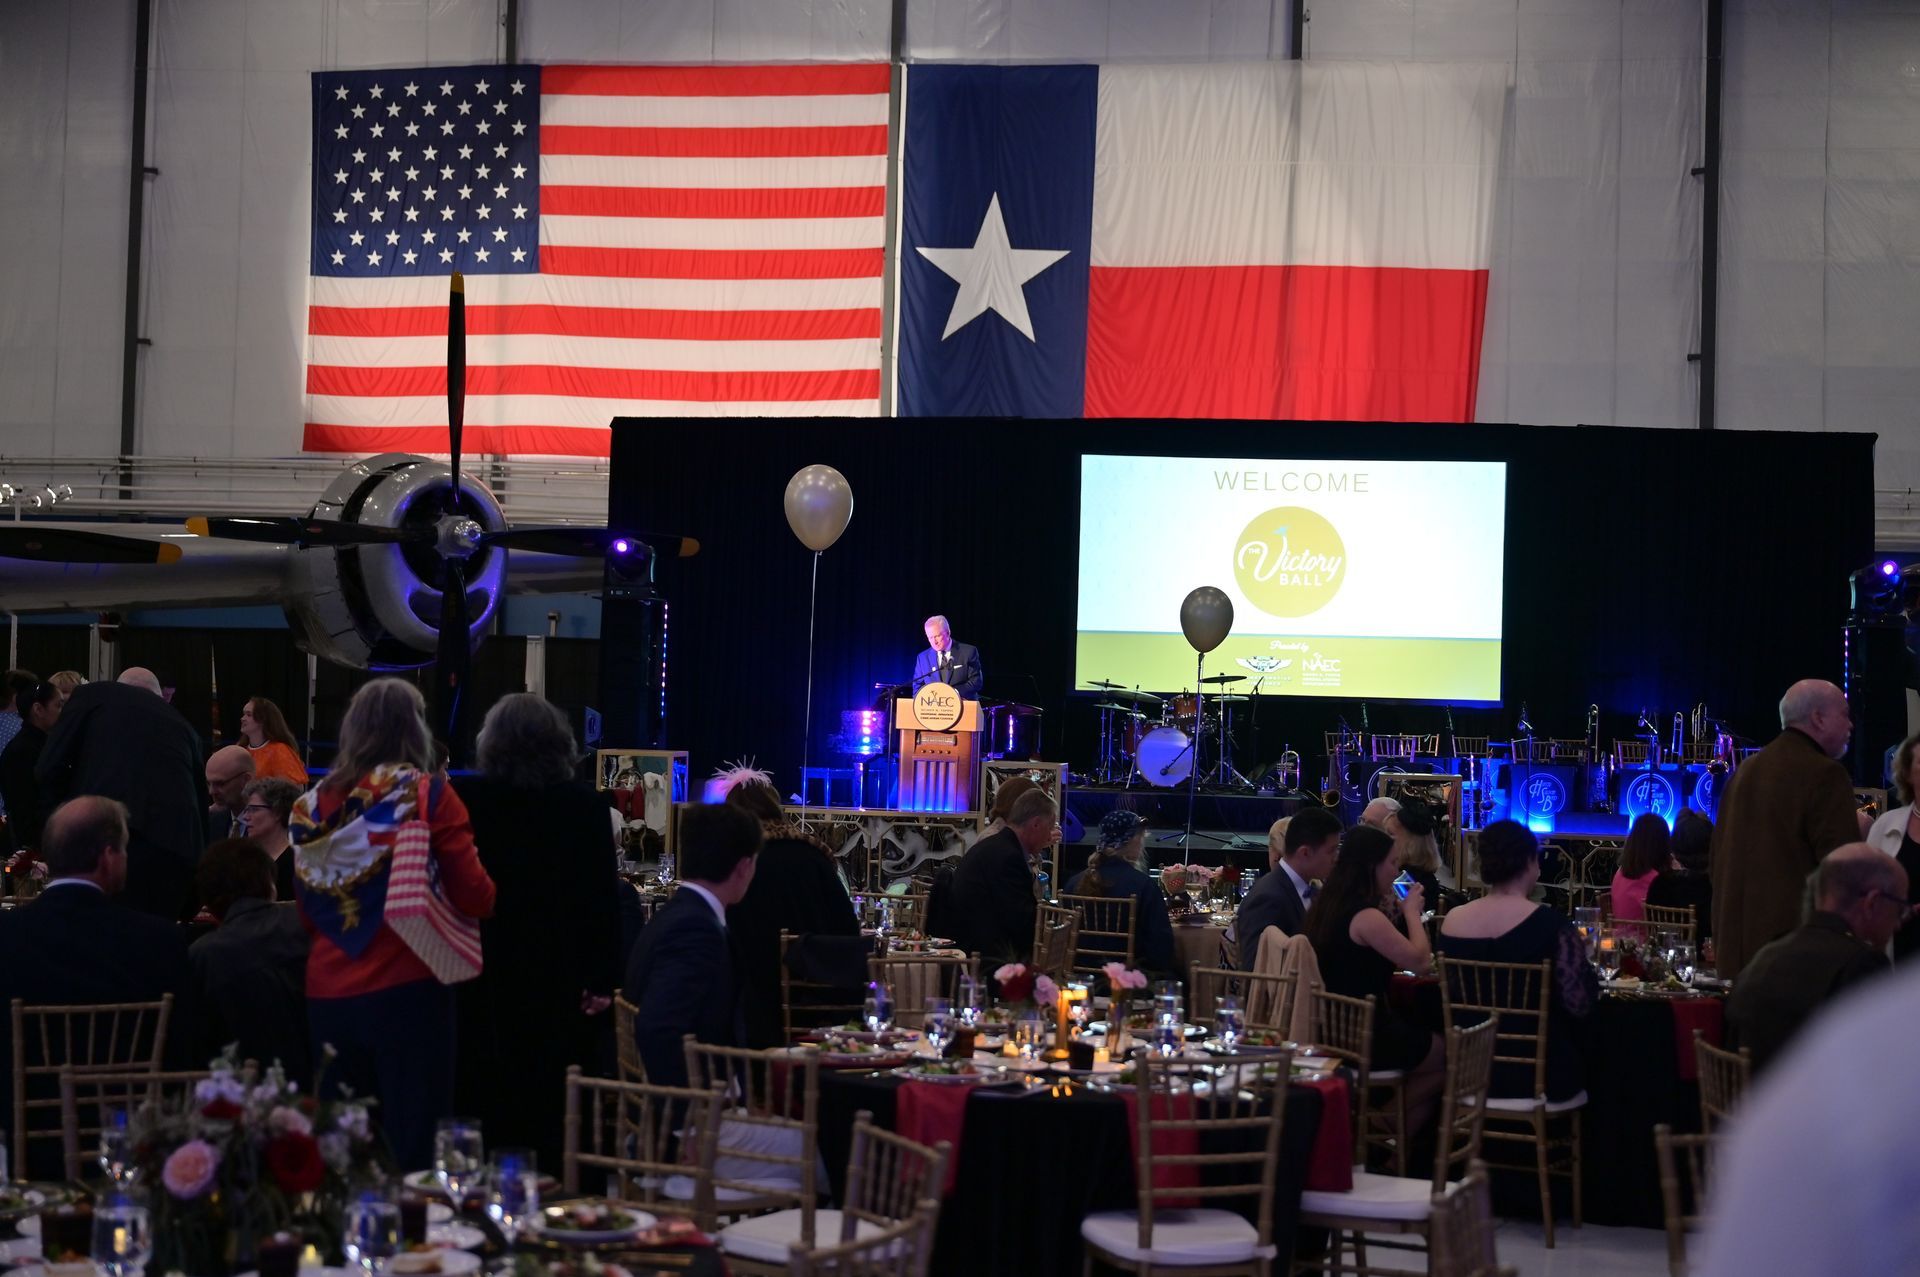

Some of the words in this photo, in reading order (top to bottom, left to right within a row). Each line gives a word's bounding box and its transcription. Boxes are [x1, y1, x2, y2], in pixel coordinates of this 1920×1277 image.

[1214, 470, 1369, 493] WELCOME
[1238, 535, 1342, 582] Victory
[1279, 573, 1322, 586] BALL
[1302, 658, 1341, 672] NAEC
[920, 696, 954, 708] NAEC
